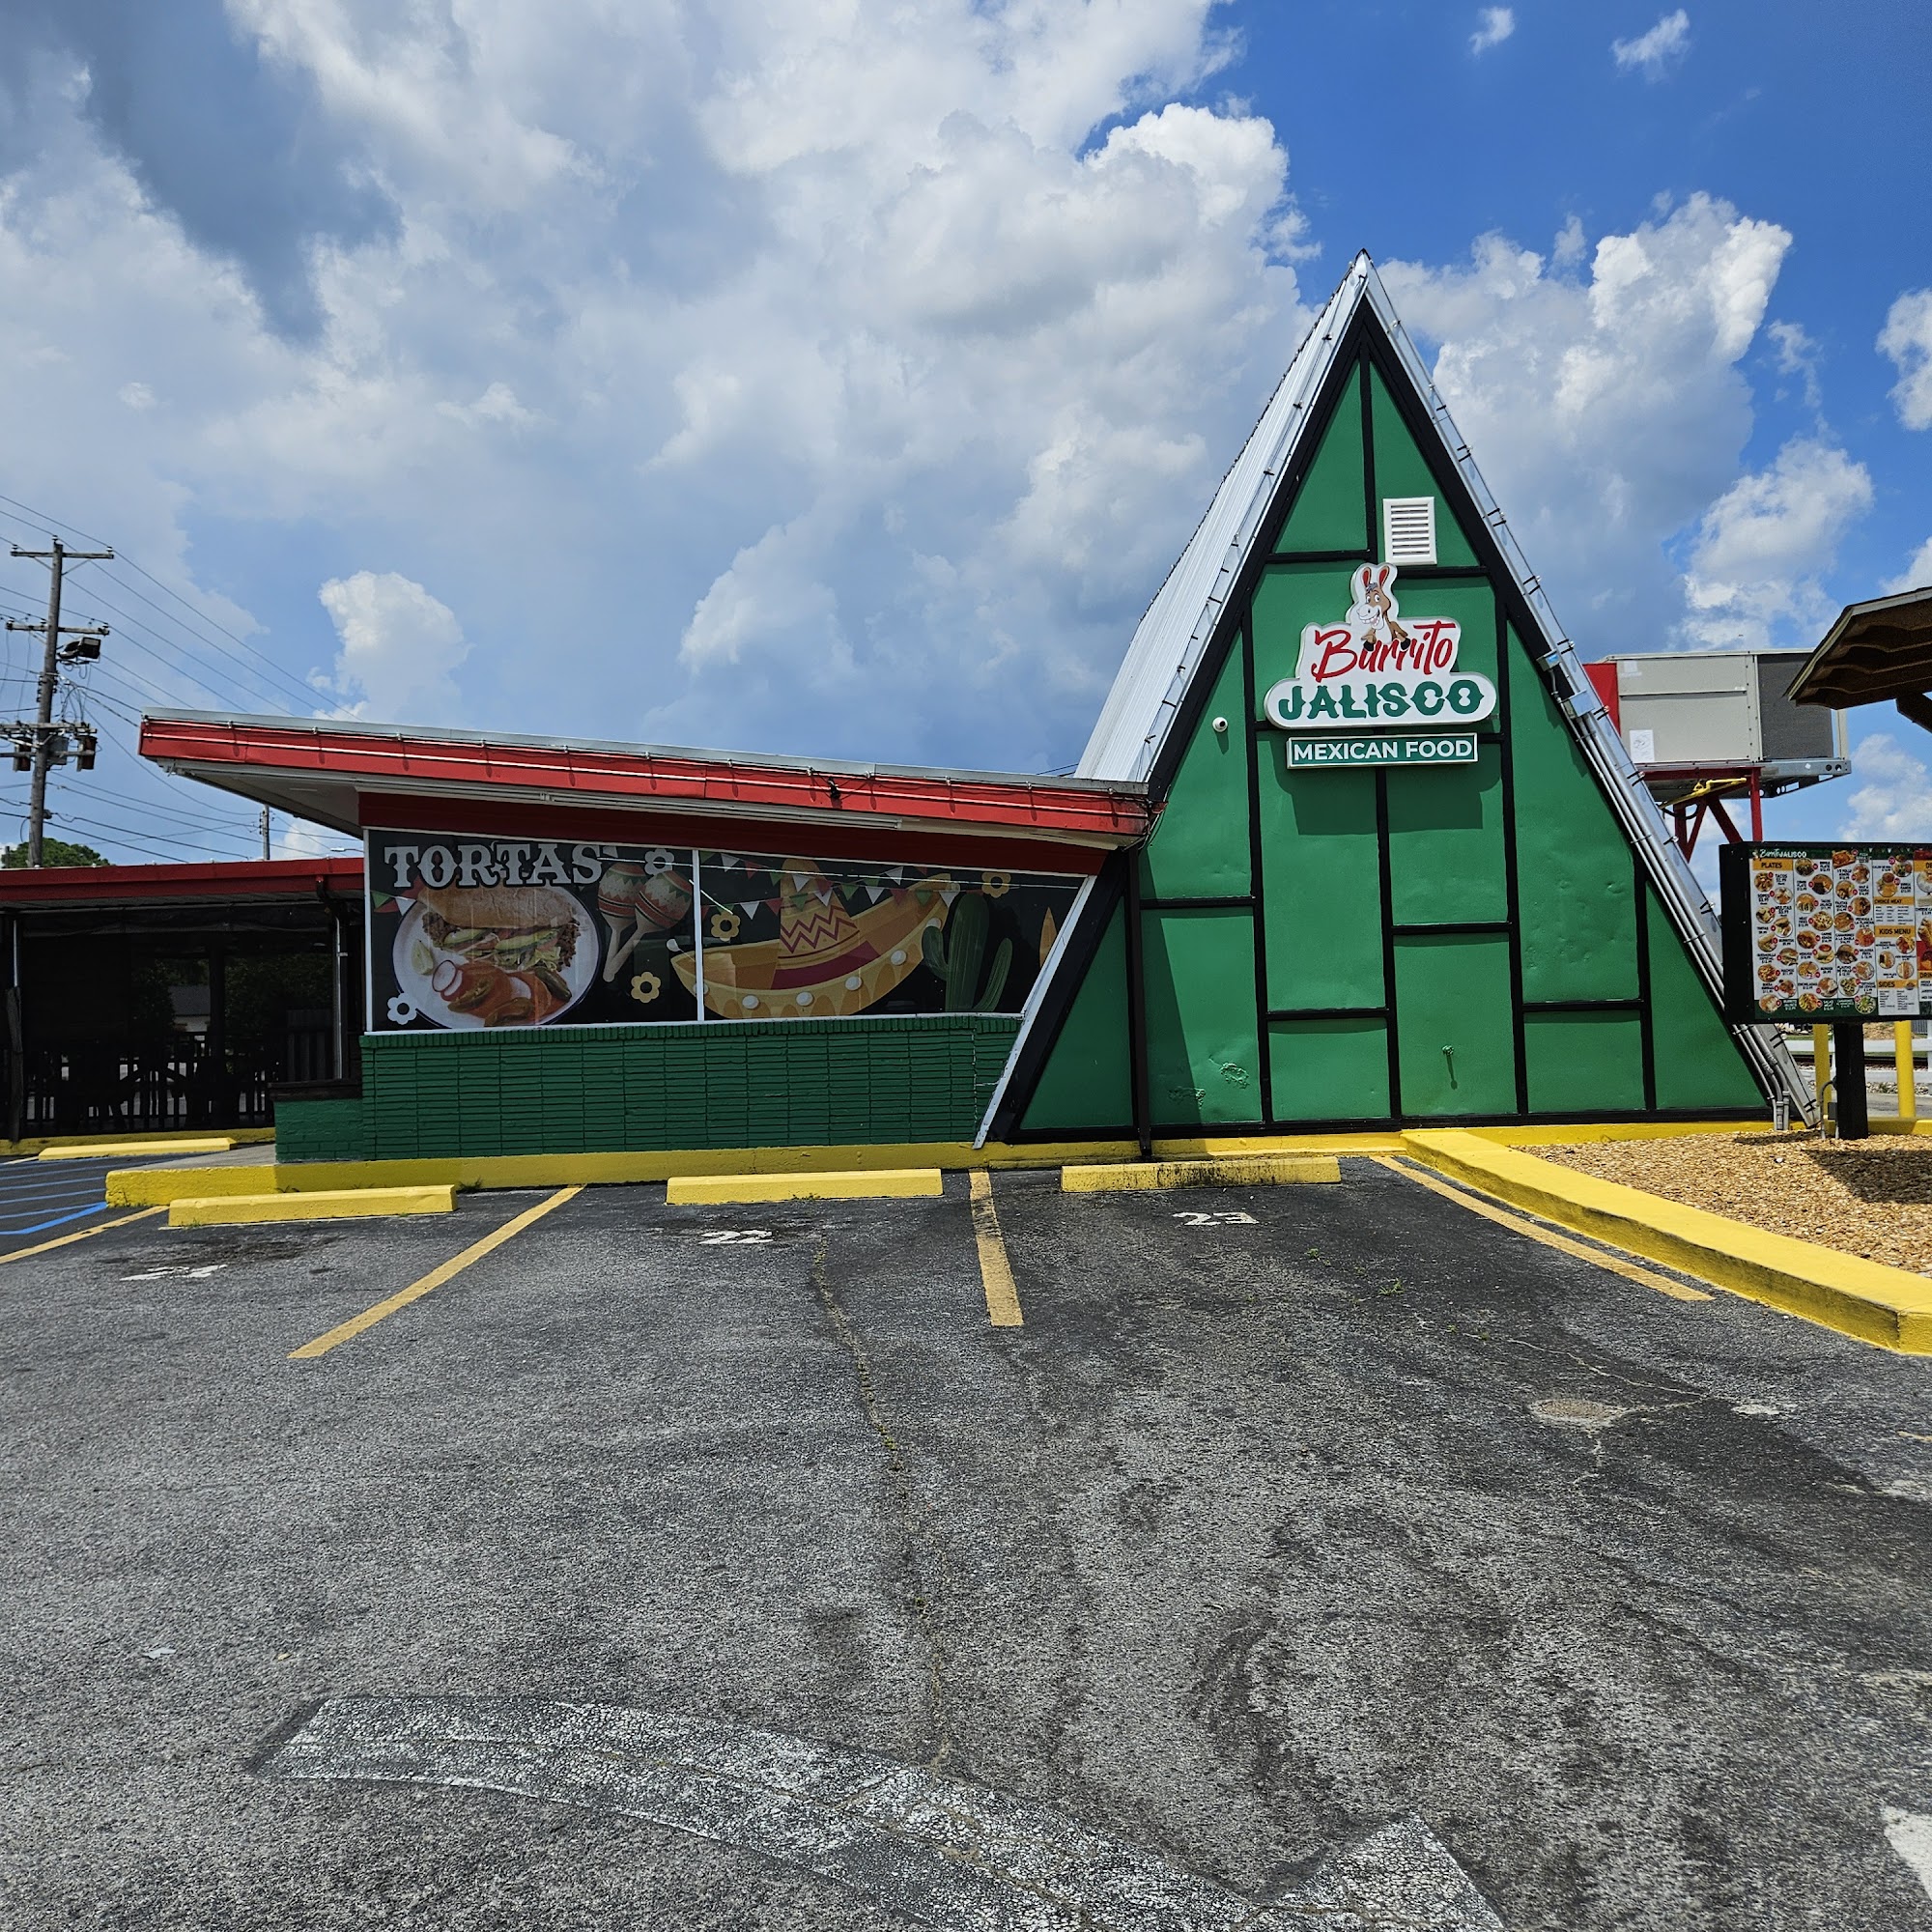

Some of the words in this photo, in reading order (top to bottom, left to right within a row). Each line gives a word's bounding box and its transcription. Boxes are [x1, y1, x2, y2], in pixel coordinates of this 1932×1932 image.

[1311, 620, 1457, 683] Burrito
[1278, 679, 1485, 721] JALISCO
[1293, 741, 1399, 761] MEXICAN
[1405, 740, 1473, 758] FOOD
[384, 843, 603, 889] TORTAS
